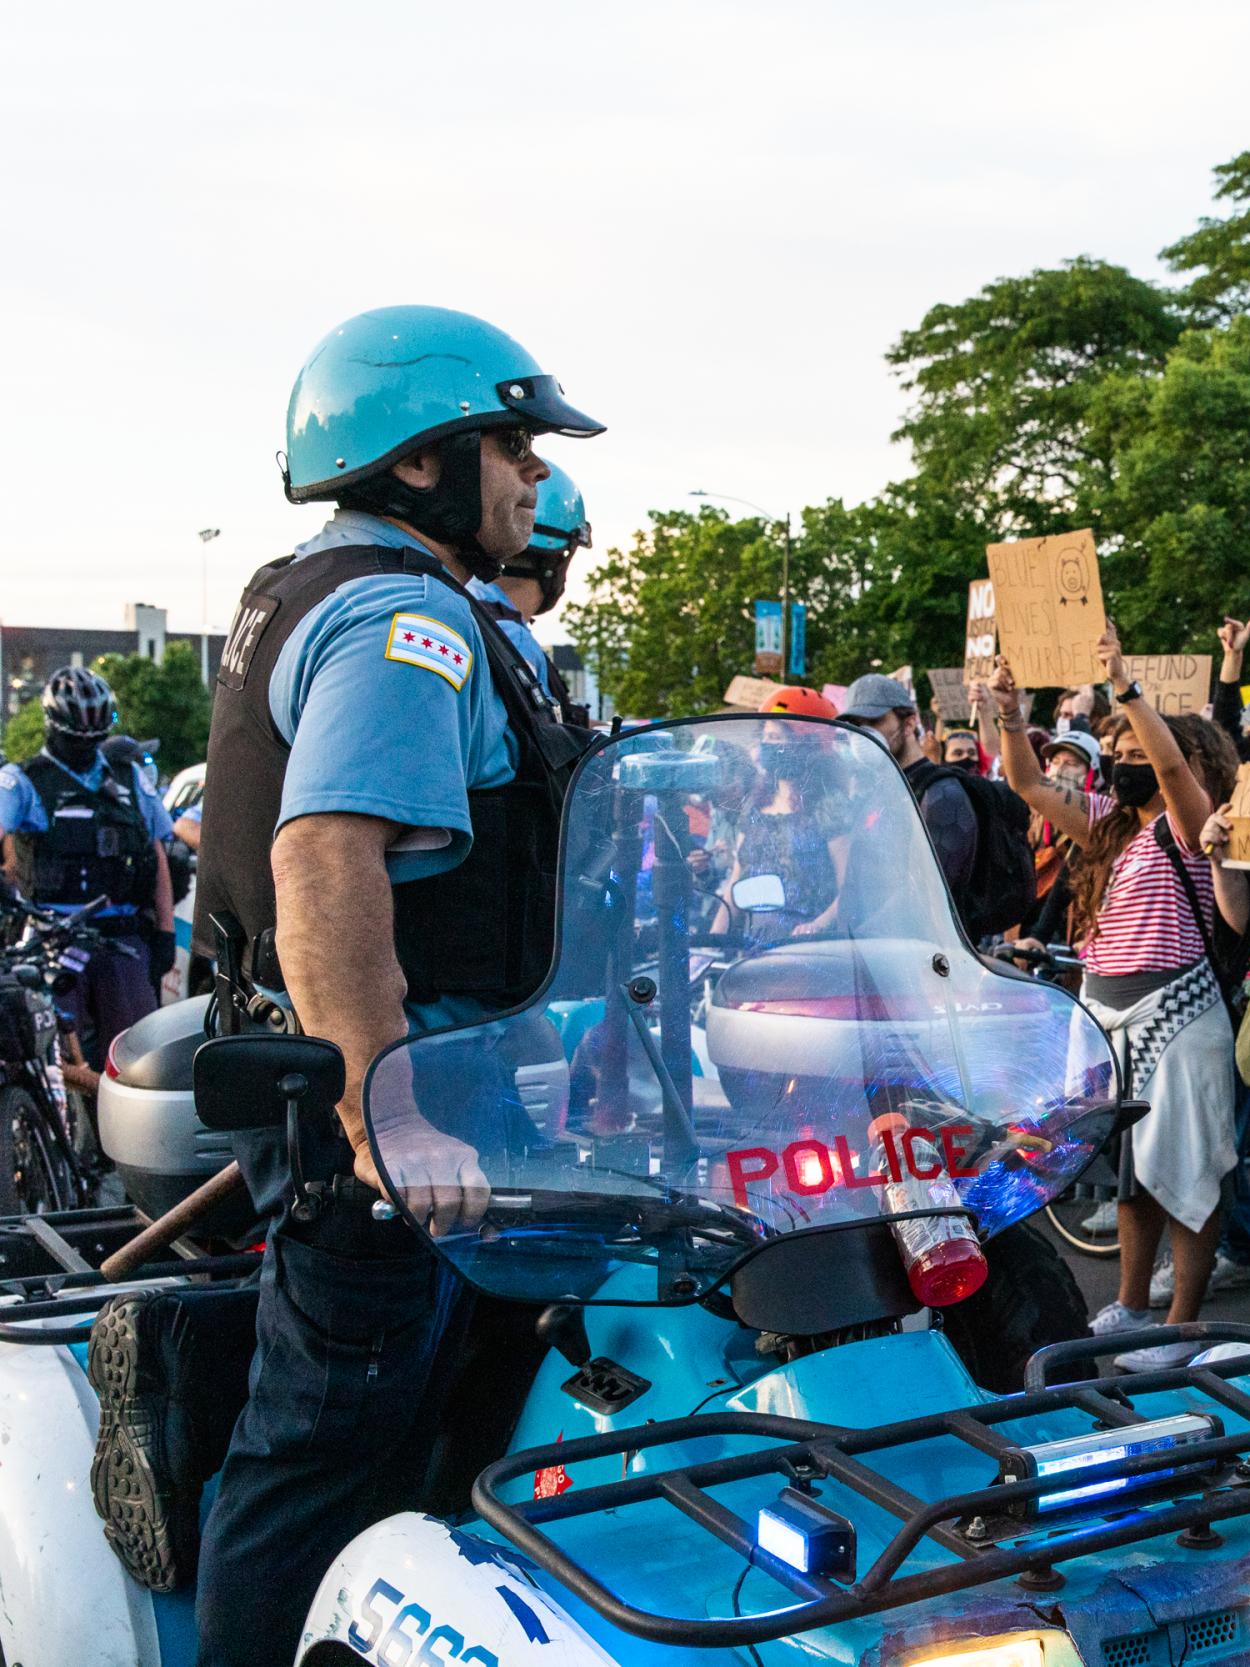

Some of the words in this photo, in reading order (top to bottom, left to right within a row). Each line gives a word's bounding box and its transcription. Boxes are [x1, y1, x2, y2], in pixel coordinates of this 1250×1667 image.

[992, 549, 1046, 588] BLUE
[969, 581, 996, 619] NO
[1001, 600, 1052, 636] LIVES
[967, 634, 993, 657] NO
[726, 1124, 980, 1207] POLICE
